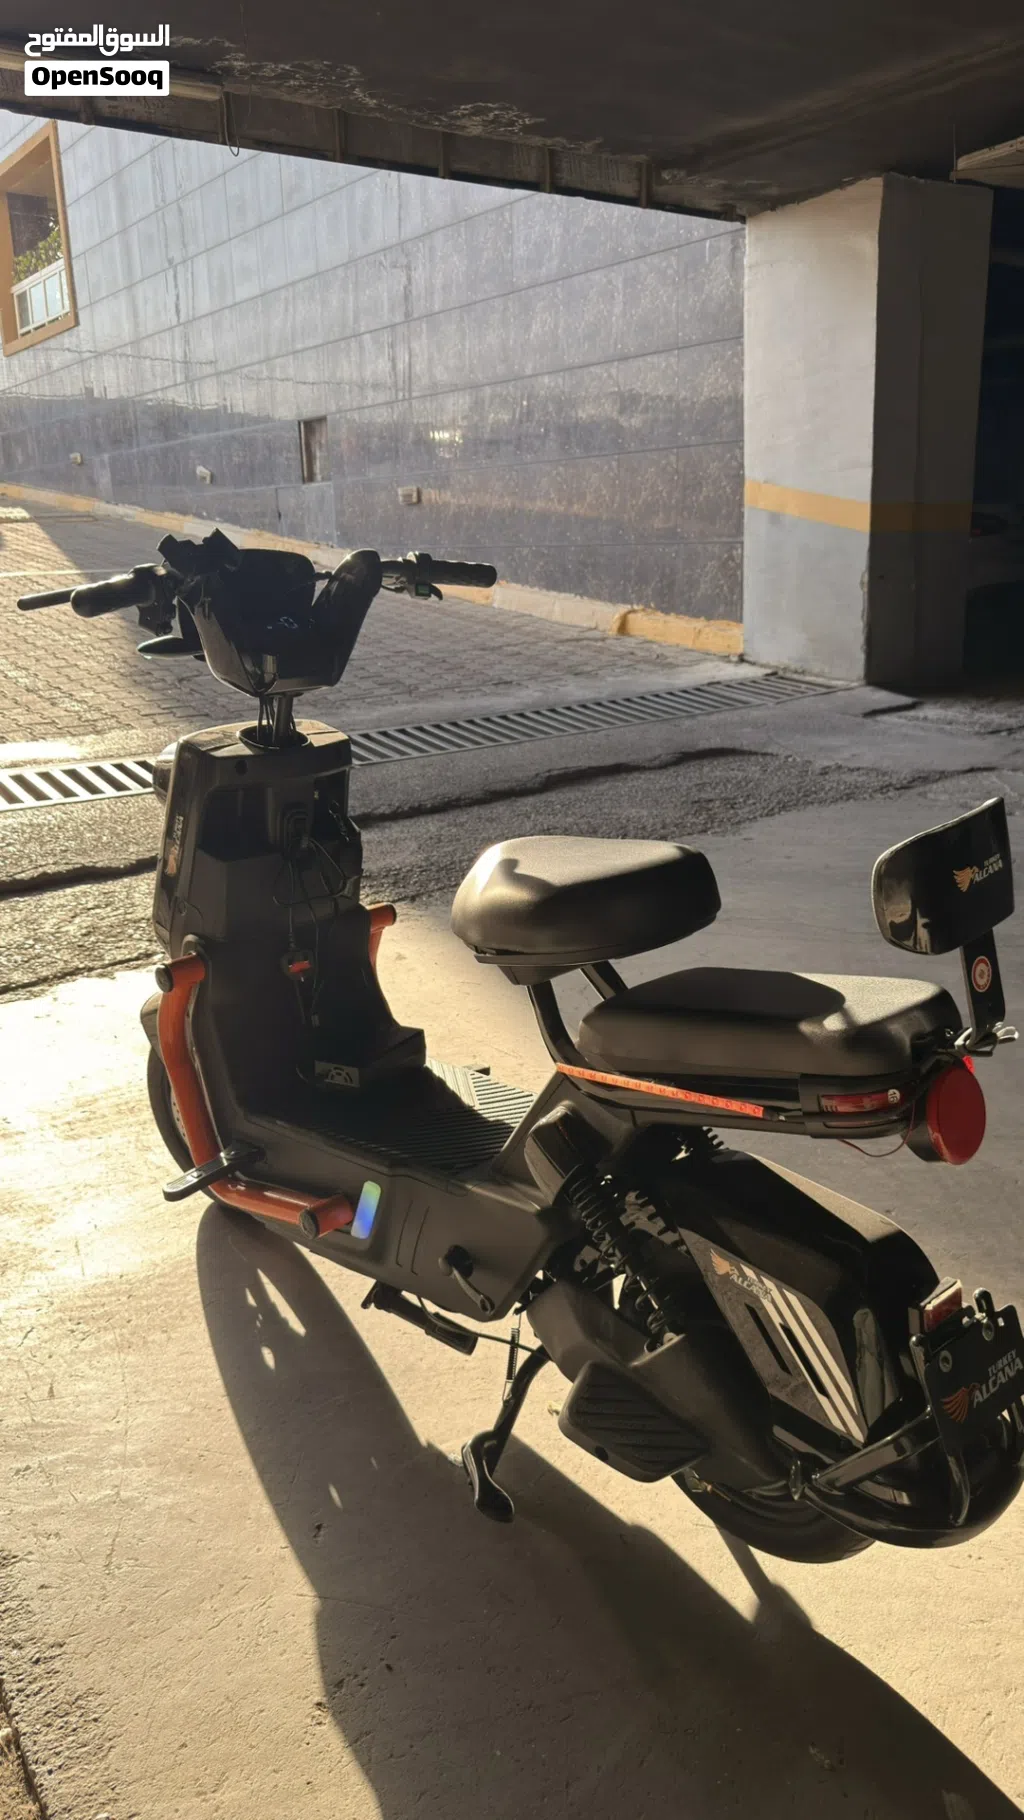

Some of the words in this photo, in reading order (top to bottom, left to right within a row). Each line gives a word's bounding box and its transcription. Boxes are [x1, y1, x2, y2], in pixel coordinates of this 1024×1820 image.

[973, 859, 1003, 884] ALCANA
[988, 1349, 1016, 1376] TURKEY
[973, 1357, 1023, 1408] ALCANA
